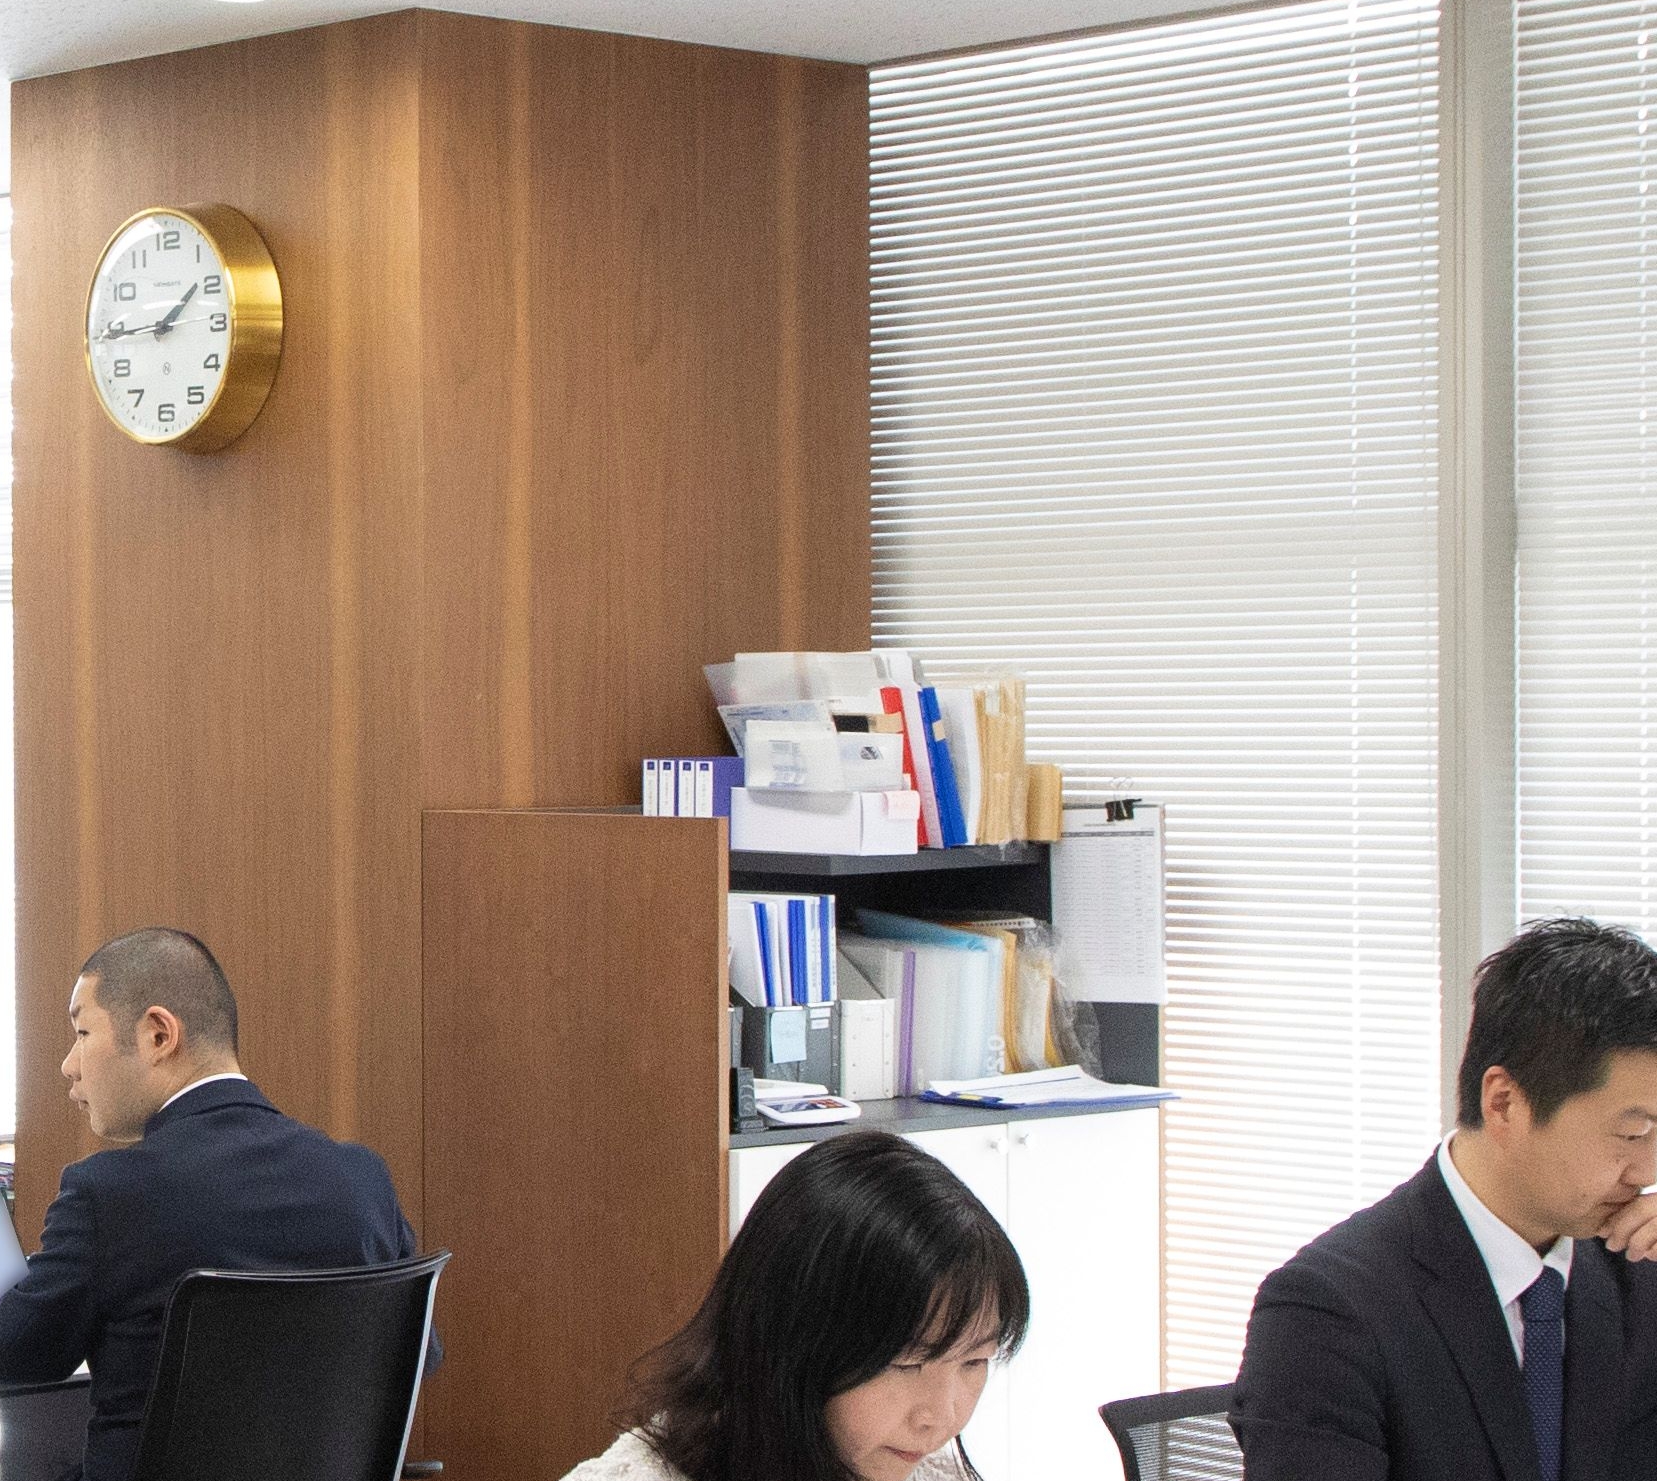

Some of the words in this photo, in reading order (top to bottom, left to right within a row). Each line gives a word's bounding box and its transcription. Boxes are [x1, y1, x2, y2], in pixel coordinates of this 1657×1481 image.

[156, 231, 180, 251] 12
[132, 250, 147, 269] 11
[196, 244, 201, 263] 1
[113, 282, 136, 302] 10
[203, 275, 221, 294] 2
[209, 313, 227, 332] 3
[113, 359, 131, 378] 8
[203, 353, 221, 372] 4
[127, 389, 145, 408] 7
[187, 386, 205, 405] 5
[158, 404, 176, 422] 6
